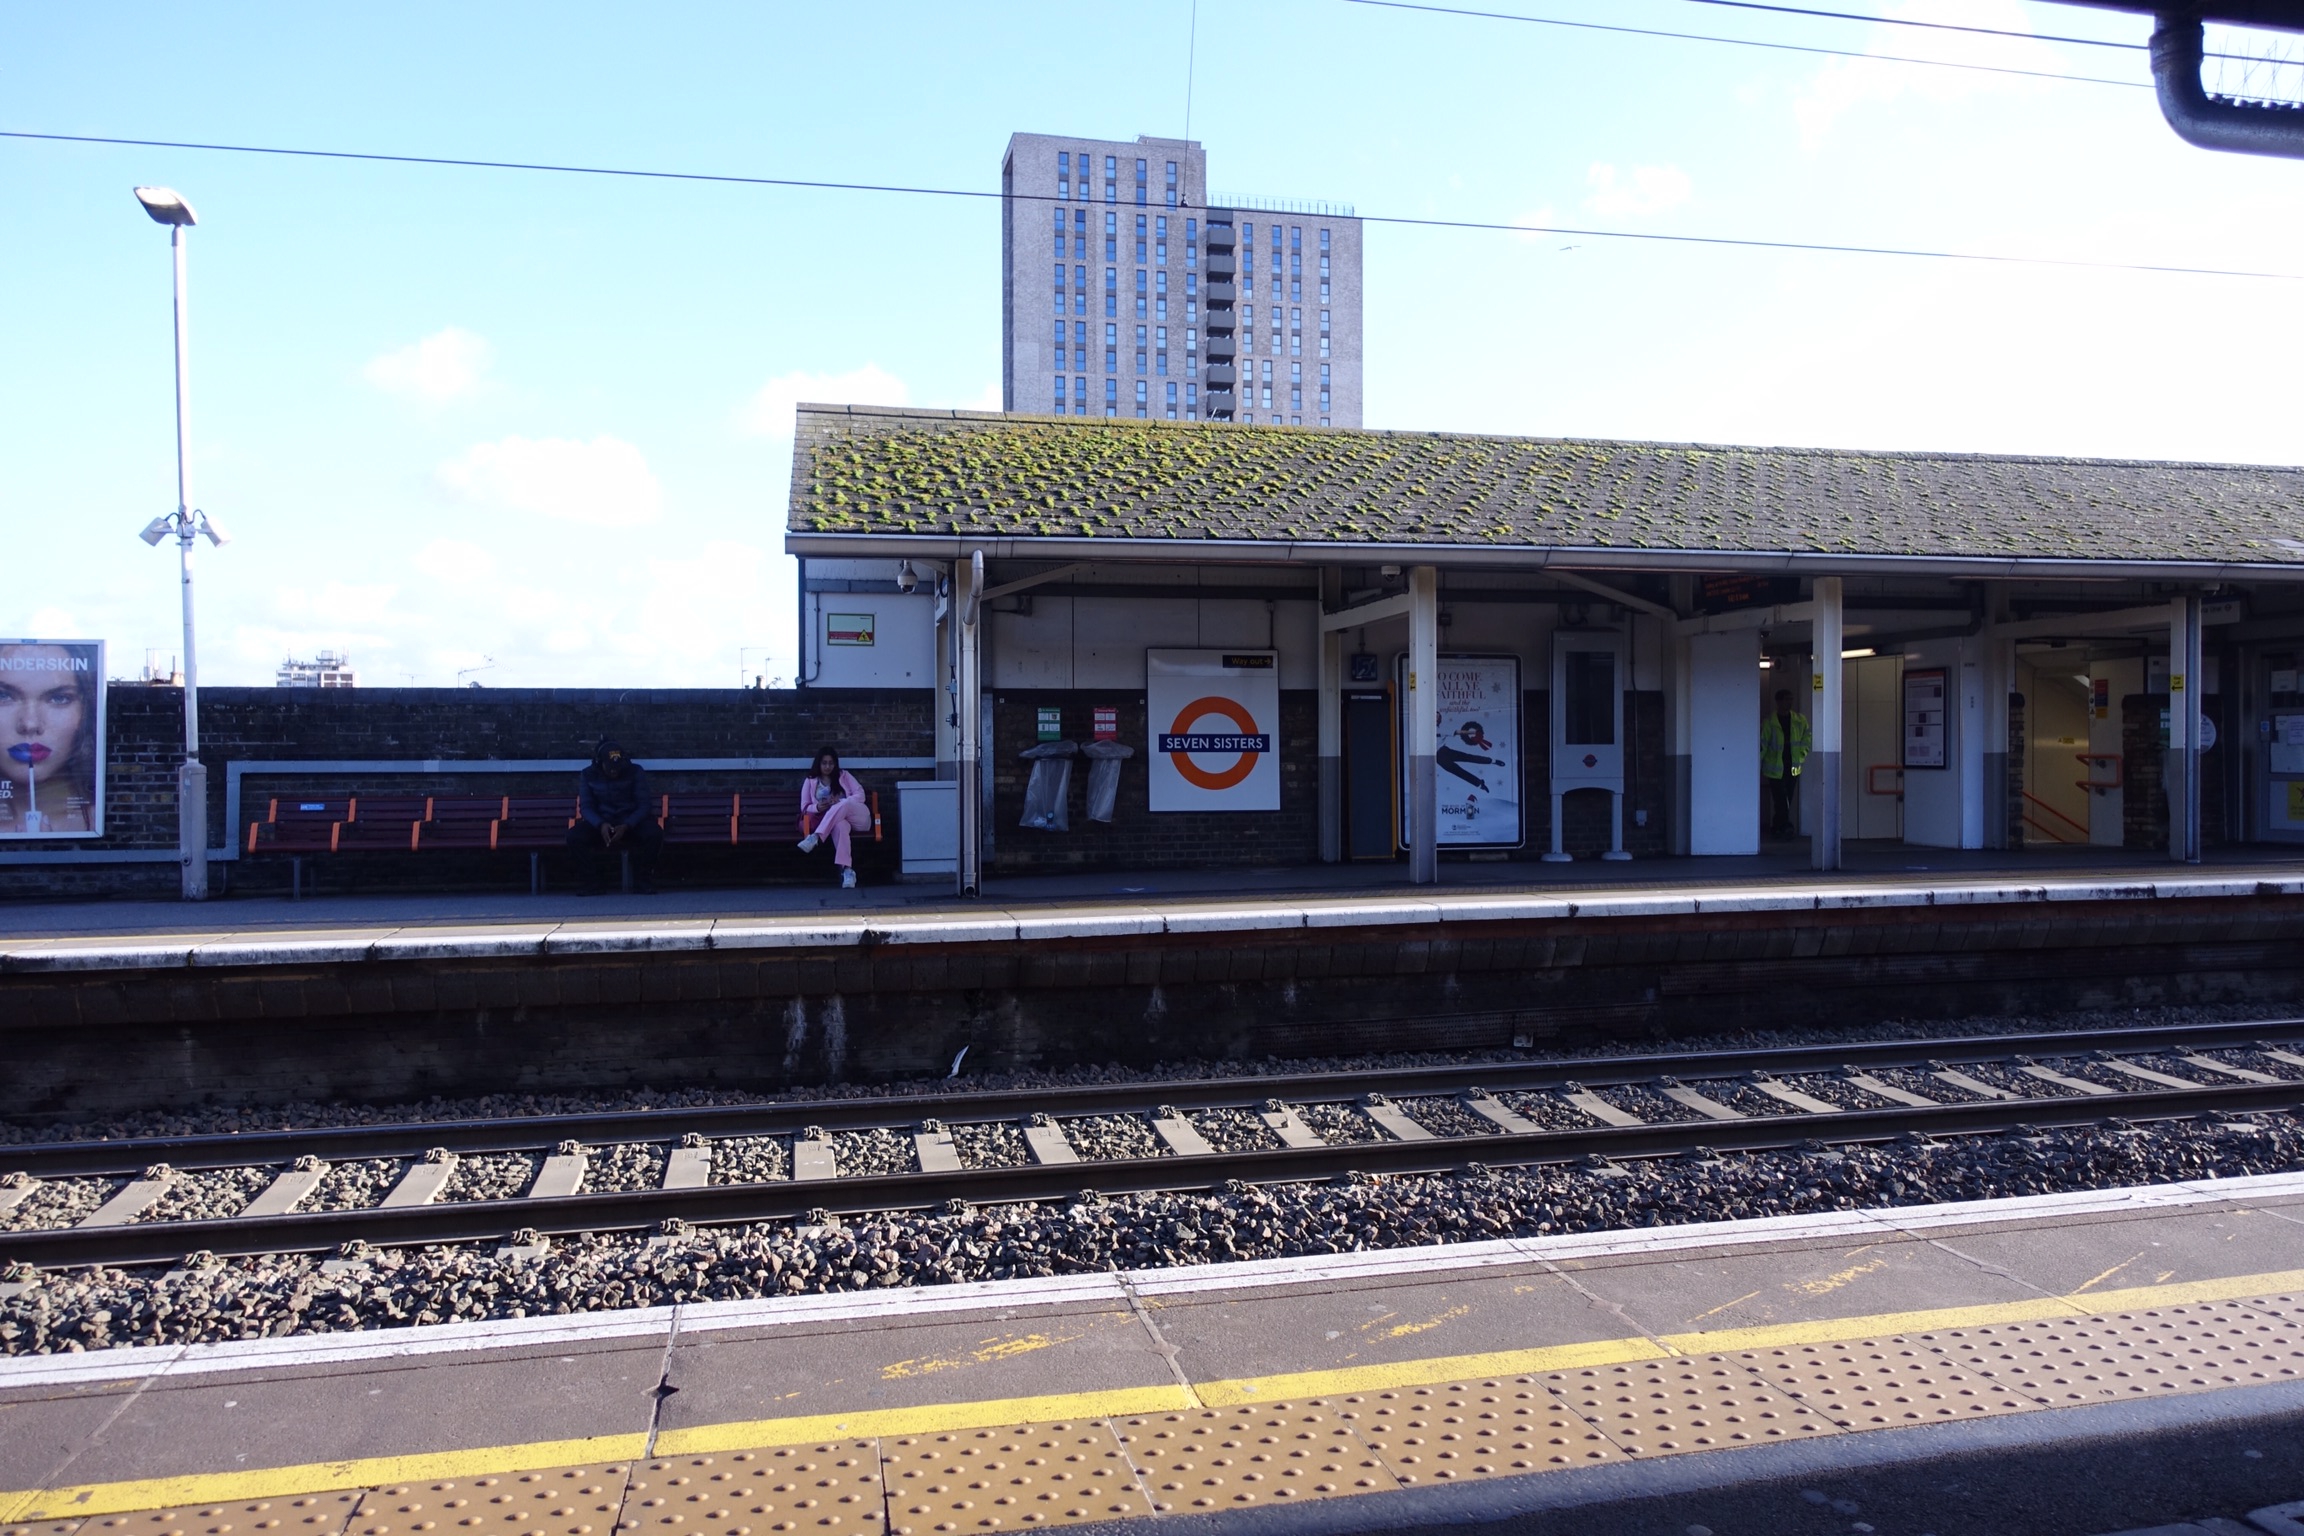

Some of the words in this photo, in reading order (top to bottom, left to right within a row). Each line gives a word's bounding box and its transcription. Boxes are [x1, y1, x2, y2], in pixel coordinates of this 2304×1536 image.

[1231, 657, 1248, 666] Way
[1438, 672, 1447, 681] O
[1449, 672, 1482, 681] COME
[1442, 681, 1464, 690] ALL
[1465, 681, 1480, 690] YE
[1166, 737, 1209, 749] SEVEN
[1213, 737, 1263, 749] SISTERS
